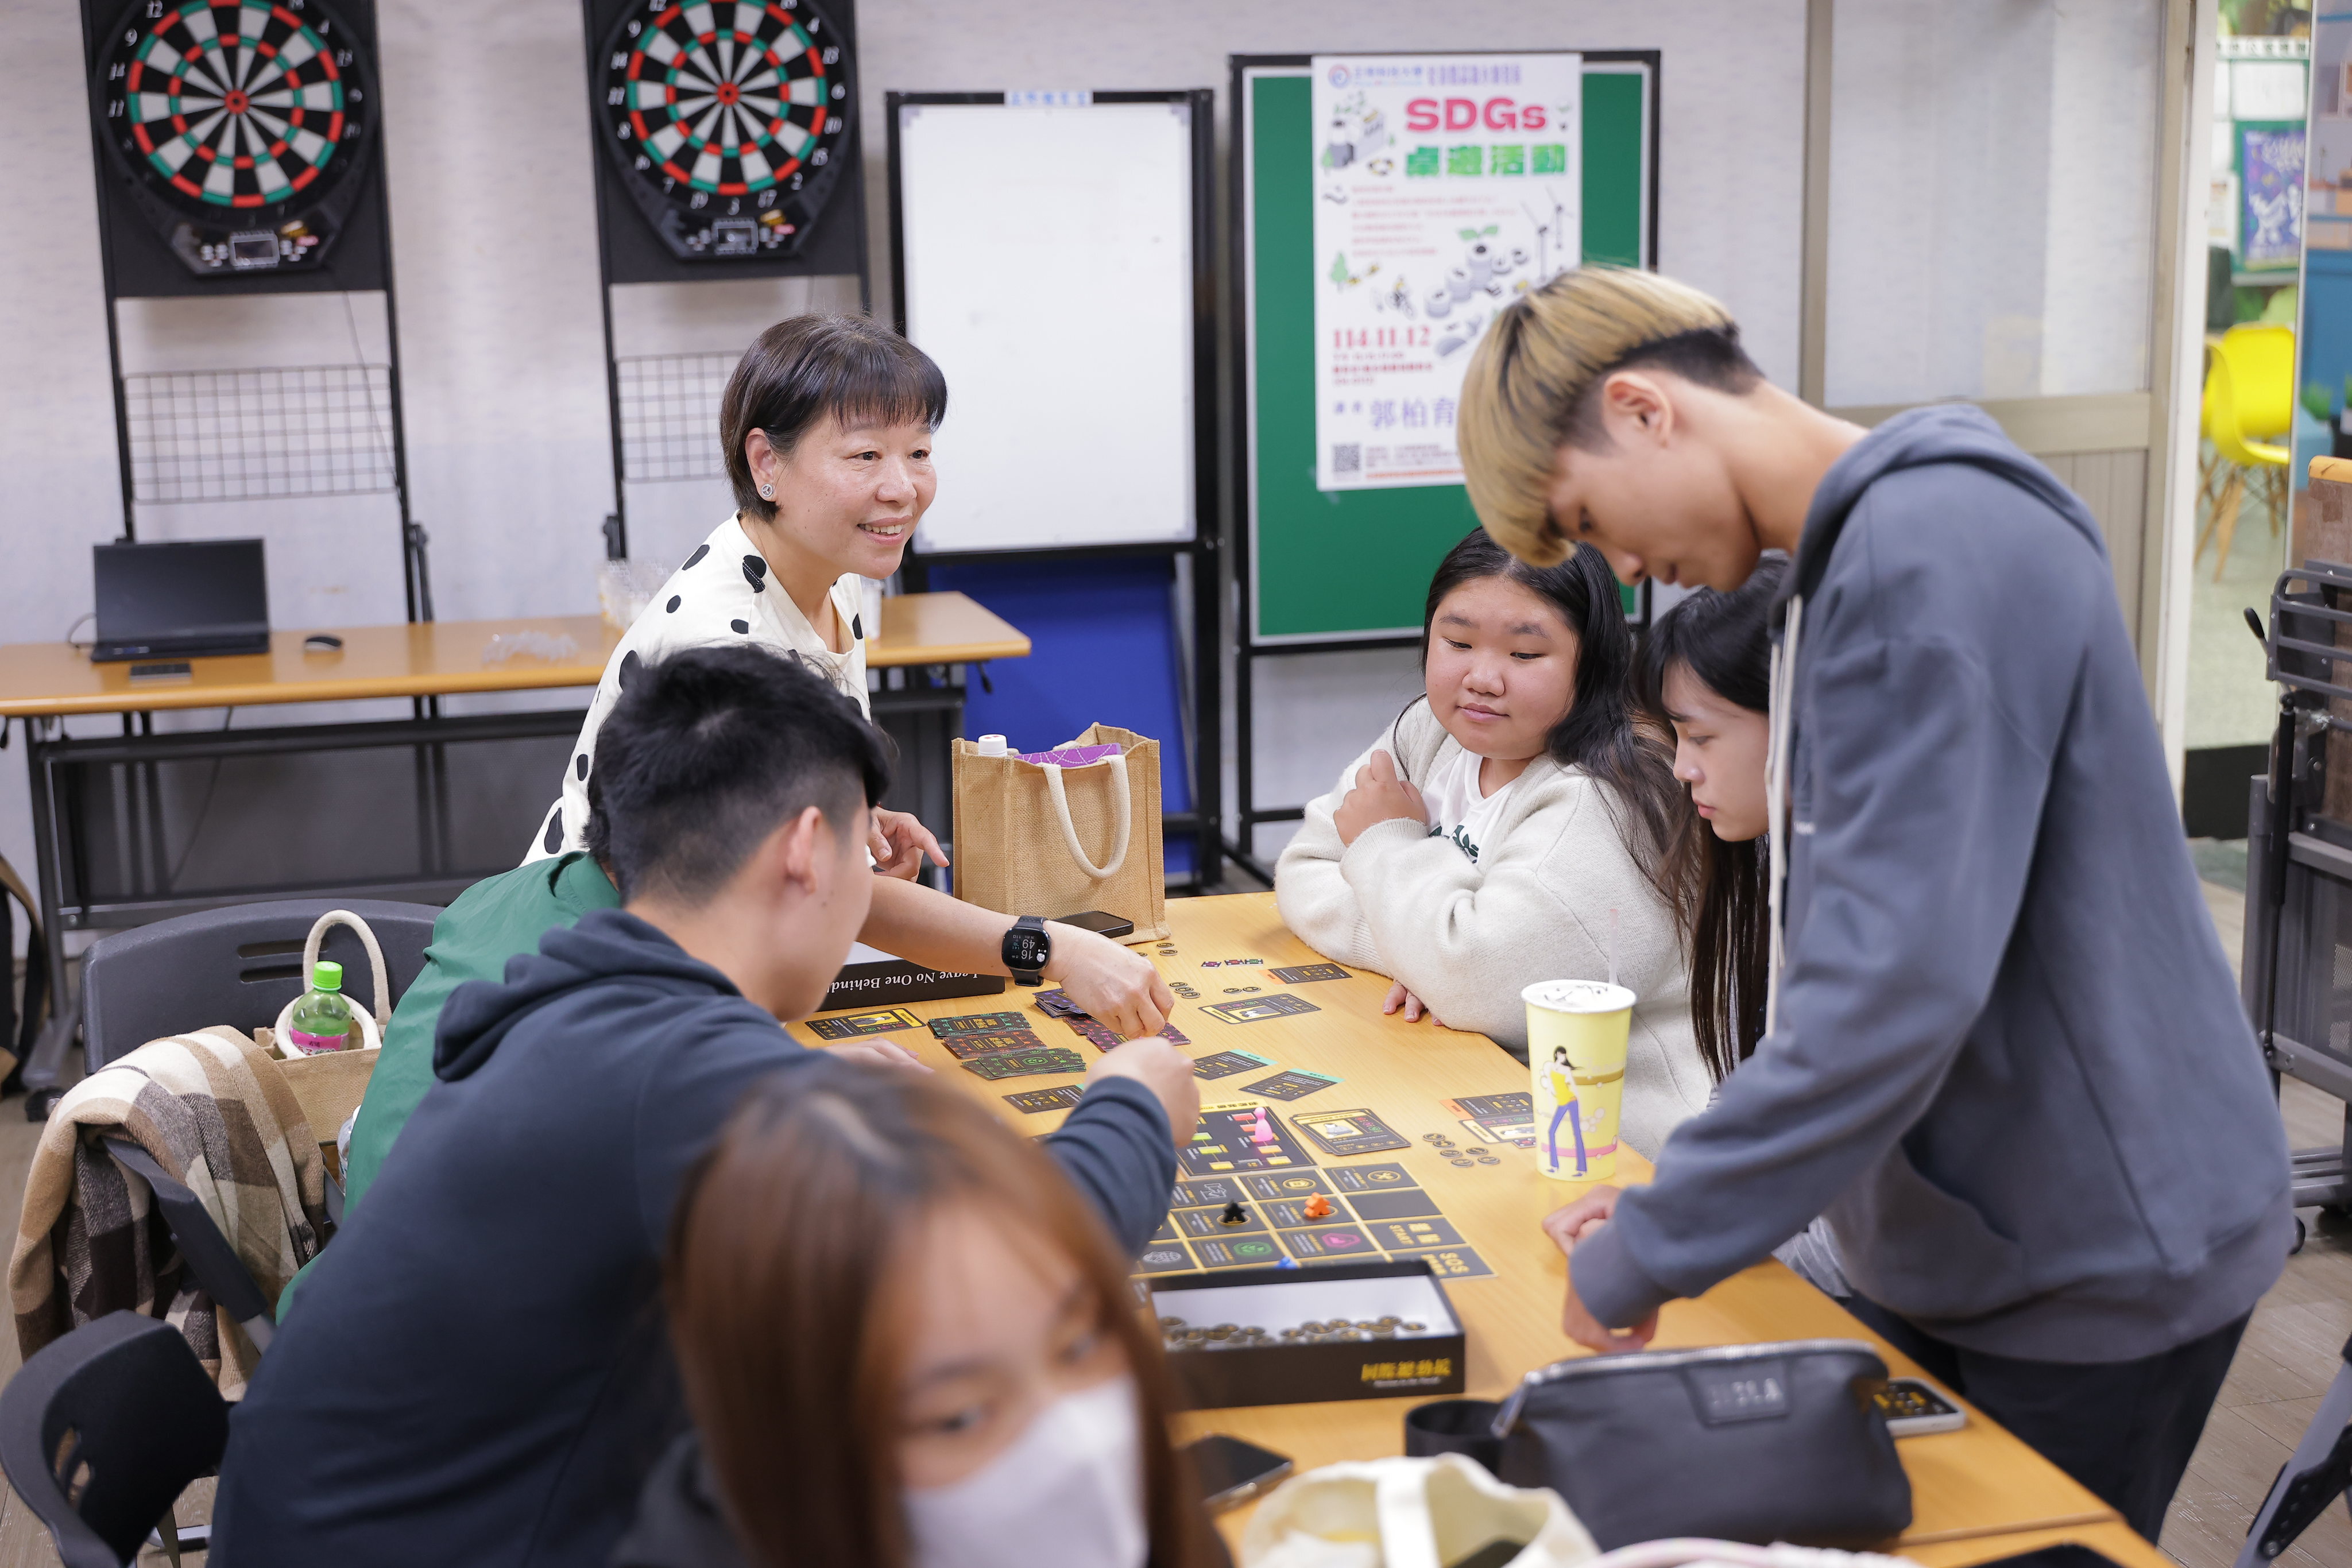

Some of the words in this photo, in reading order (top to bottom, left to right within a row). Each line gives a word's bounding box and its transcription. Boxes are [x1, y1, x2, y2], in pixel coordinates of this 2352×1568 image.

[125, 28, 137, 47] 9
[109, 100, 125, 117] 11
[1405, 98, 1546, 131] SDGs
[1022, 939, 1035, 949] 49
[1022, 950, 1032, 960] 16
[885, 974, 912, 986] One
[916, 972, 935, 984] No
[1388, 1224, 1415, 1245] START
[1439, 1252, 1470, 1273] SOS
